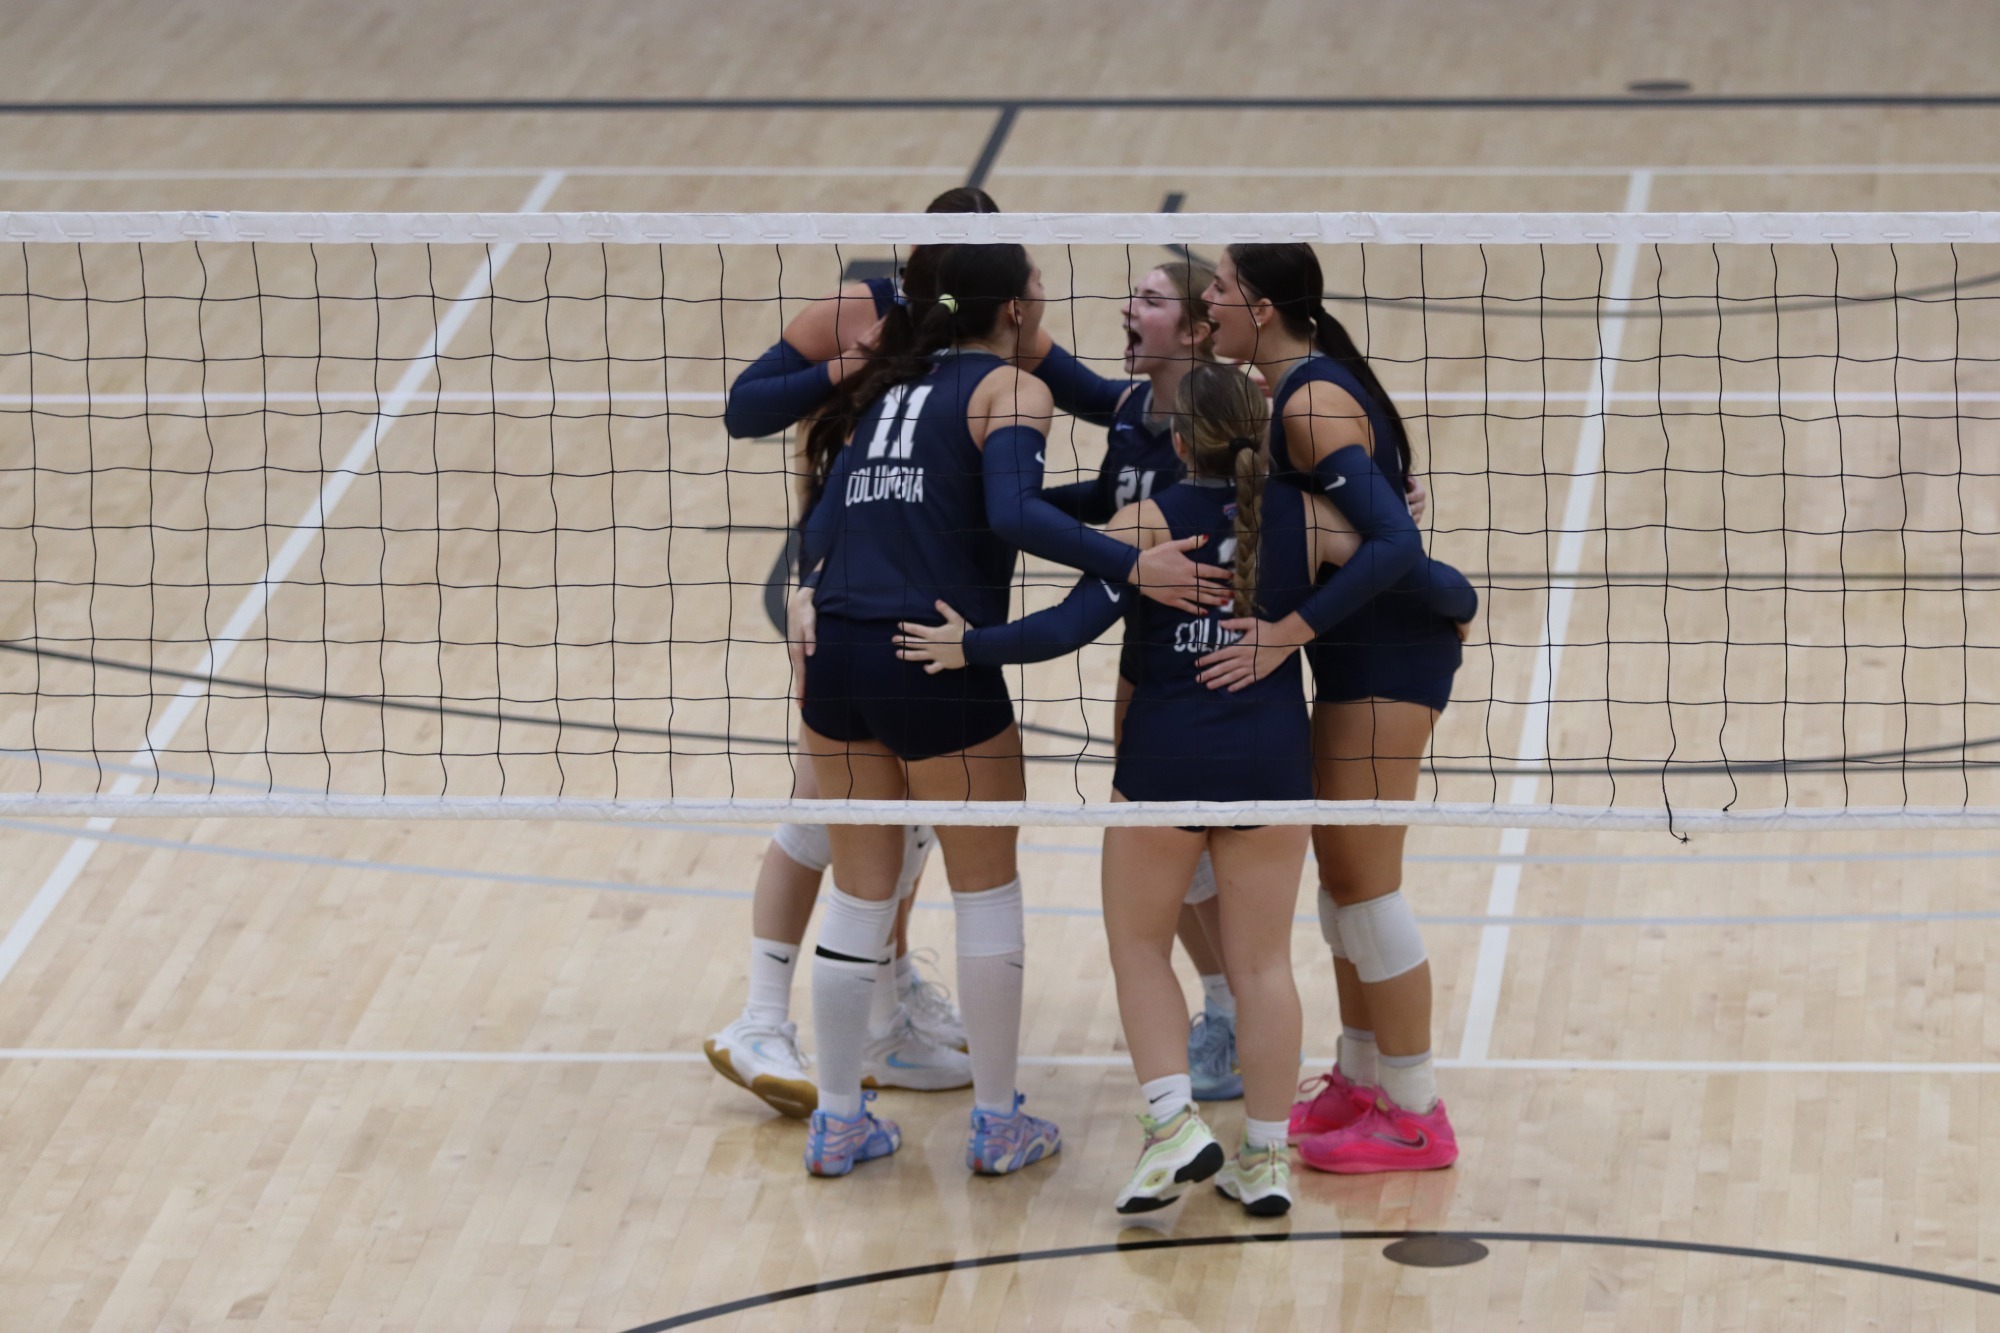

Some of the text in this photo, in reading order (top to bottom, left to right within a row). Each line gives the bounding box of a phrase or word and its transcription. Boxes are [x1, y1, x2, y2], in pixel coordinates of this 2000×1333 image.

[867, 384, 934, 460] 11
[845, 465, 924, 507] COLUMBIA
[1115, 465, 1156, 509] 21
[1173, 617, 1245, 653] COLU
